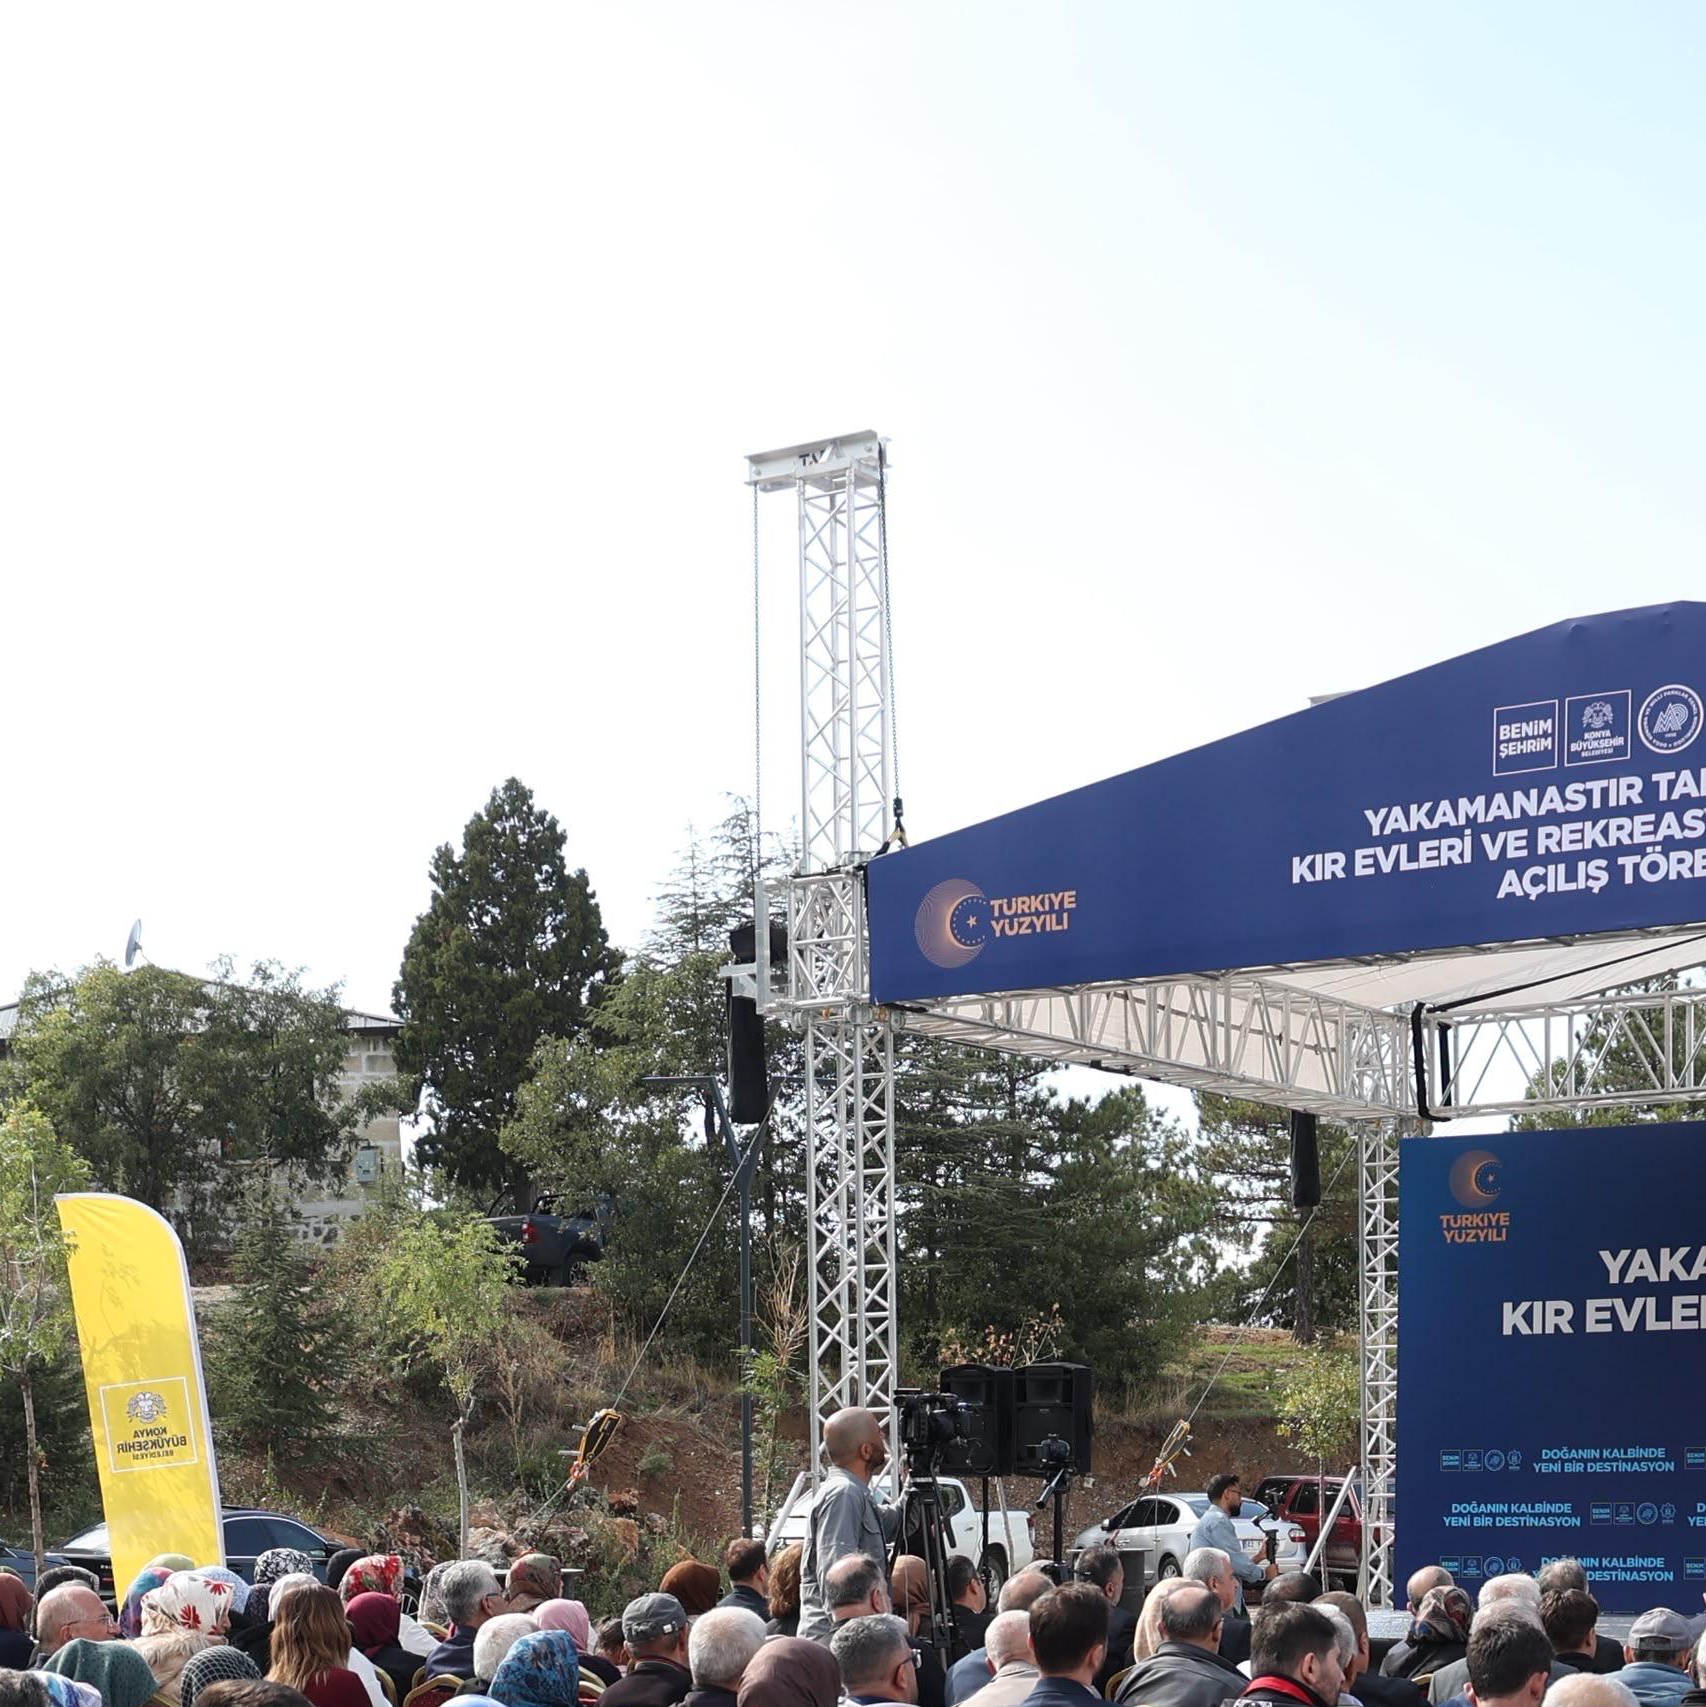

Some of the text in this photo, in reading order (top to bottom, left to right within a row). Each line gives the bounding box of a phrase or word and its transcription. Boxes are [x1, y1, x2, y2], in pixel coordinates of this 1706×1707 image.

[1584, 730, 1611, 739] KONYA
[1570, 736, 1624, 752] BÜYÜKŞEHİR
[1365, 775, 1641, 837] YAKAMANASTIR
[1293, 843, 1344, 885] KIR
[1354, 831, 1471, 877] EVLERİ
[1481, 829, 1529, 862] VE
[1496, 856, 1607, 902] AÇILIŞ
[1503, 1301, 1573, 1335] KIR
[1542, 1446, 1665, 1459] DOĞANIN KALBİNDE
[1533, 1460, 1561, 1472] YENİ
[1565, 1461, 1584, 1472] BİR
[1587, 1460, 1674, 1472] DESTİNASYON
[1452, 1501, 1571, 1513] DOĞANIN KALBİNDE
[1443, 1514, 1470, 1526] YENİ
[1473, 1515, 1493, 1526] BİR
[1496, 1514, 1580, 1526] DESTİNASYON
[1602, 1556, 1664, 1568] KALBİNDE
